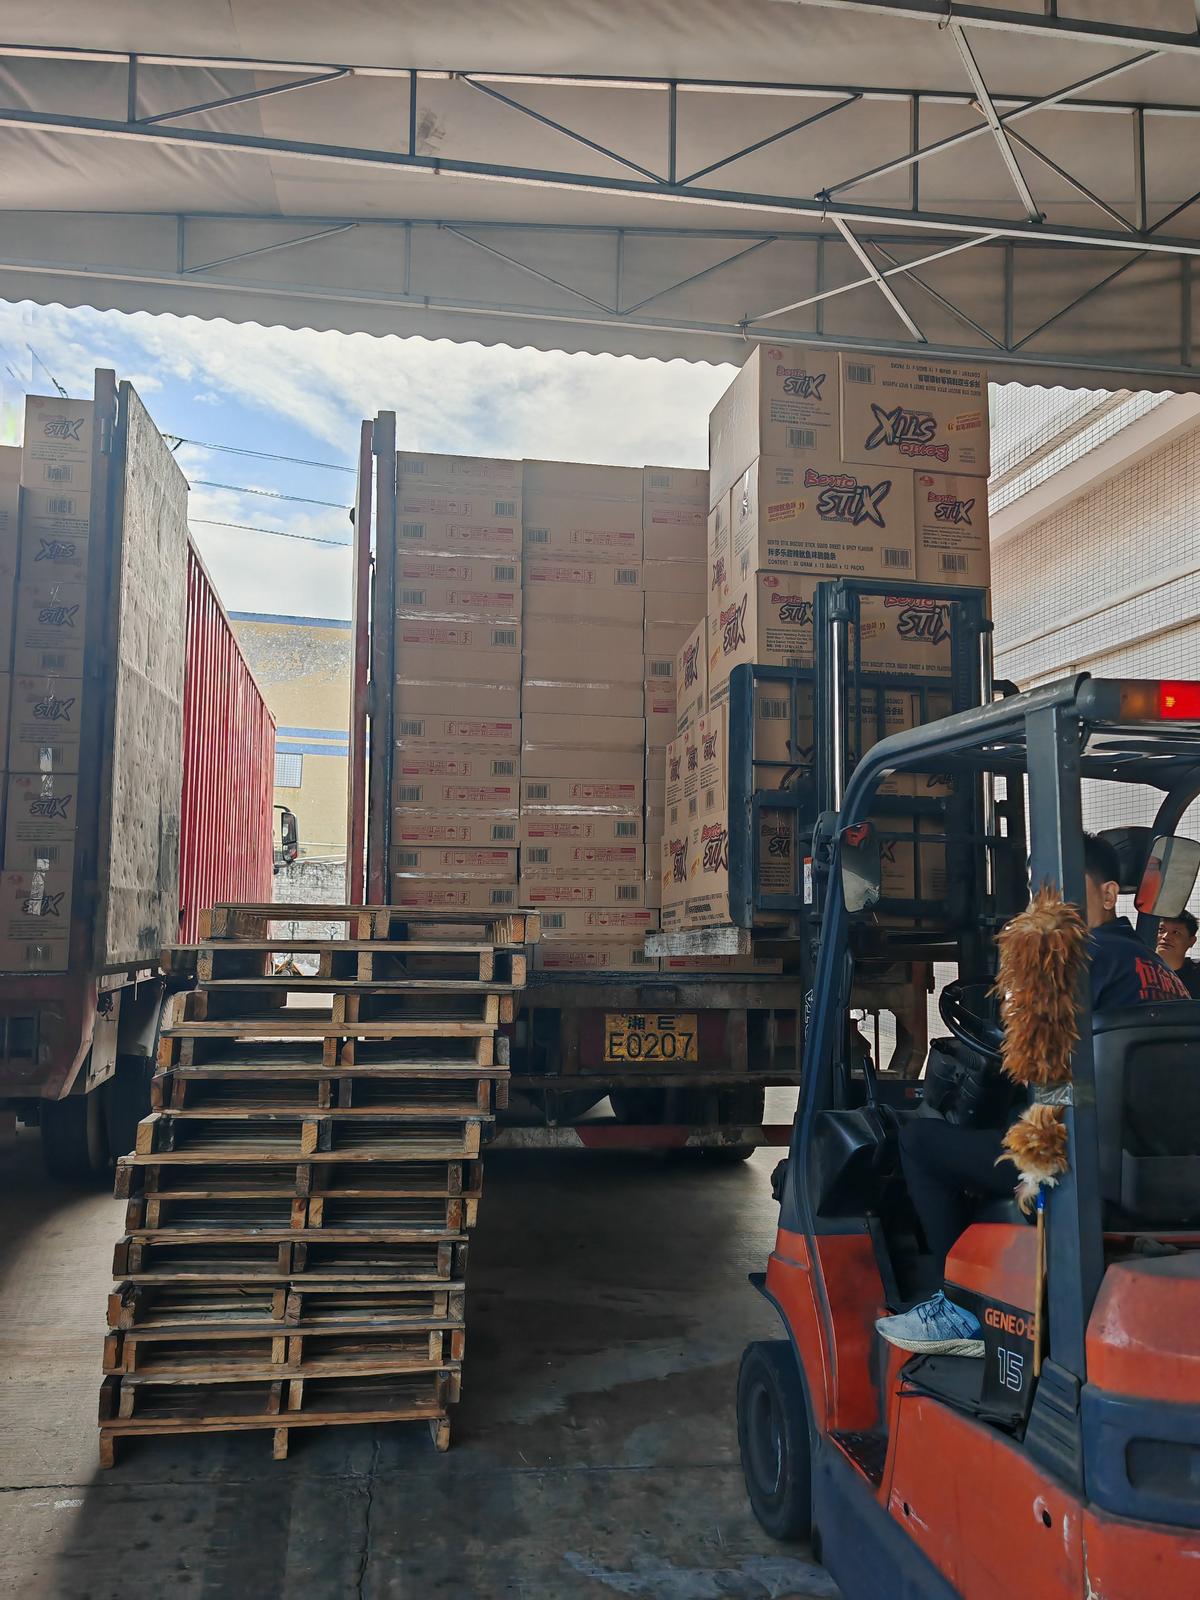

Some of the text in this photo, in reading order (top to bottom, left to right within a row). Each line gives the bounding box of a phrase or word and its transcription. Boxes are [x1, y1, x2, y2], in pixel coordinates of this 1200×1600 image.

[804, 468, 857, 489] Bento
[609, 1032, 693, 1059] E0207
[997, 1346, 1024, 1392] 15
